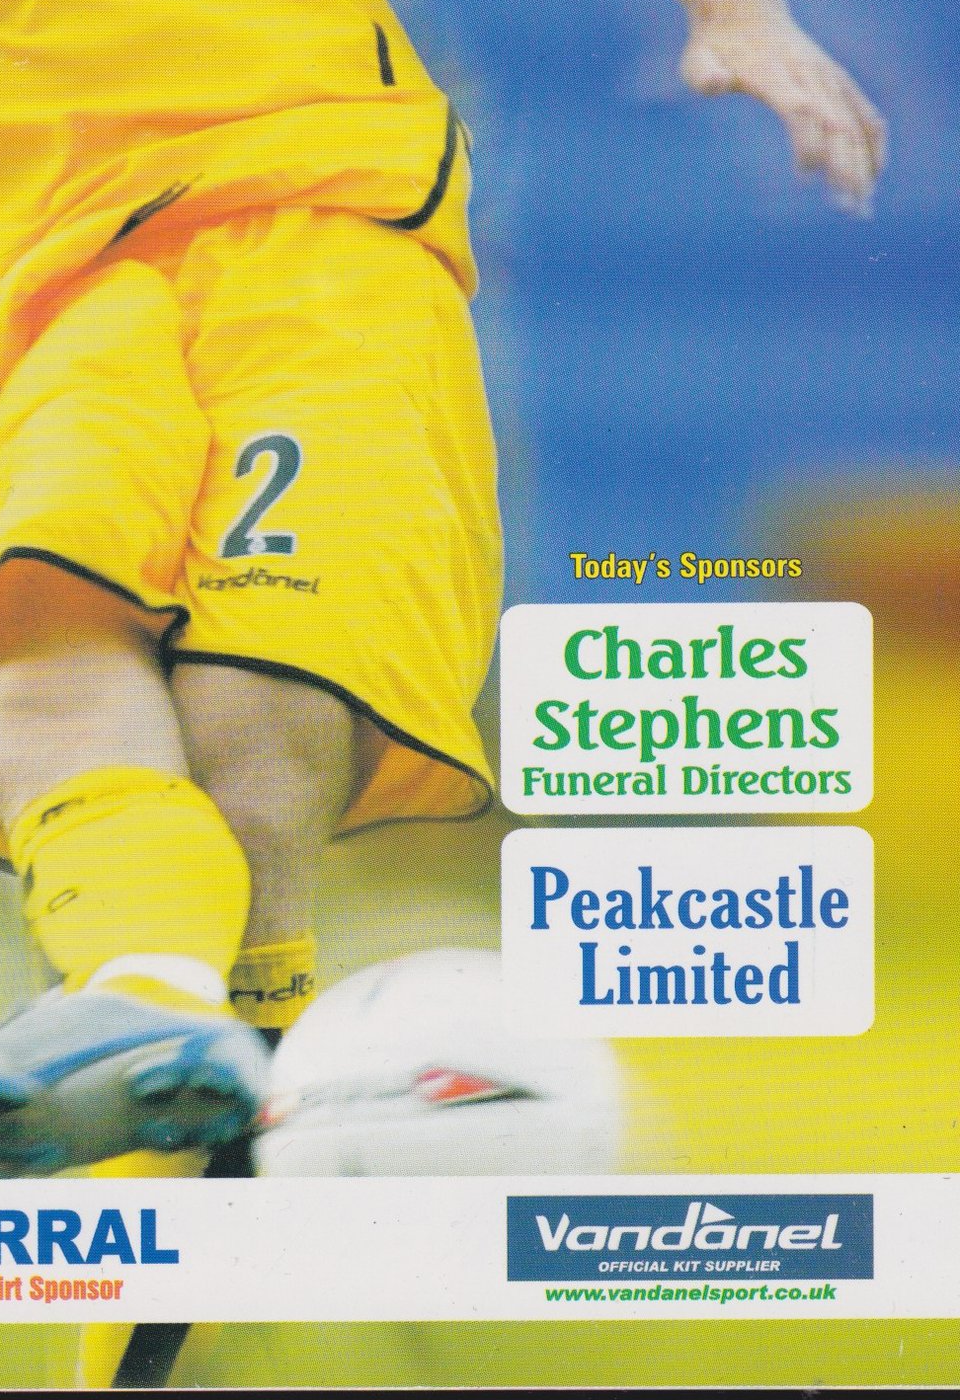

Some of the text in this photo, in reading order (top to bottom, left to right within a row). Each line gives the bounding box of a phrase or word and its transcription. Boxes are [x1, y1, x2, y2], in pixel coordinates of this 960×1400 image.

[218, 432, 302, 559] 2
[570, 552, 802, 585] Today's Sponsors
[564, 625, 808, 680] Charles
[533, 695, 840, 763] Stephens
[522, 764, 852, 797] Funeral Directors
[530, 865, 849, 930] Peakcastle
[579, 941, 800, 1005] Limited
[598, 1259, 781, 1272] OFFICIAL KIT SUPPLIER
[29, 1276, 123, 1304] Sponsor
[545, 1284, 836, 1305] www.vandanelsport.co.uk
